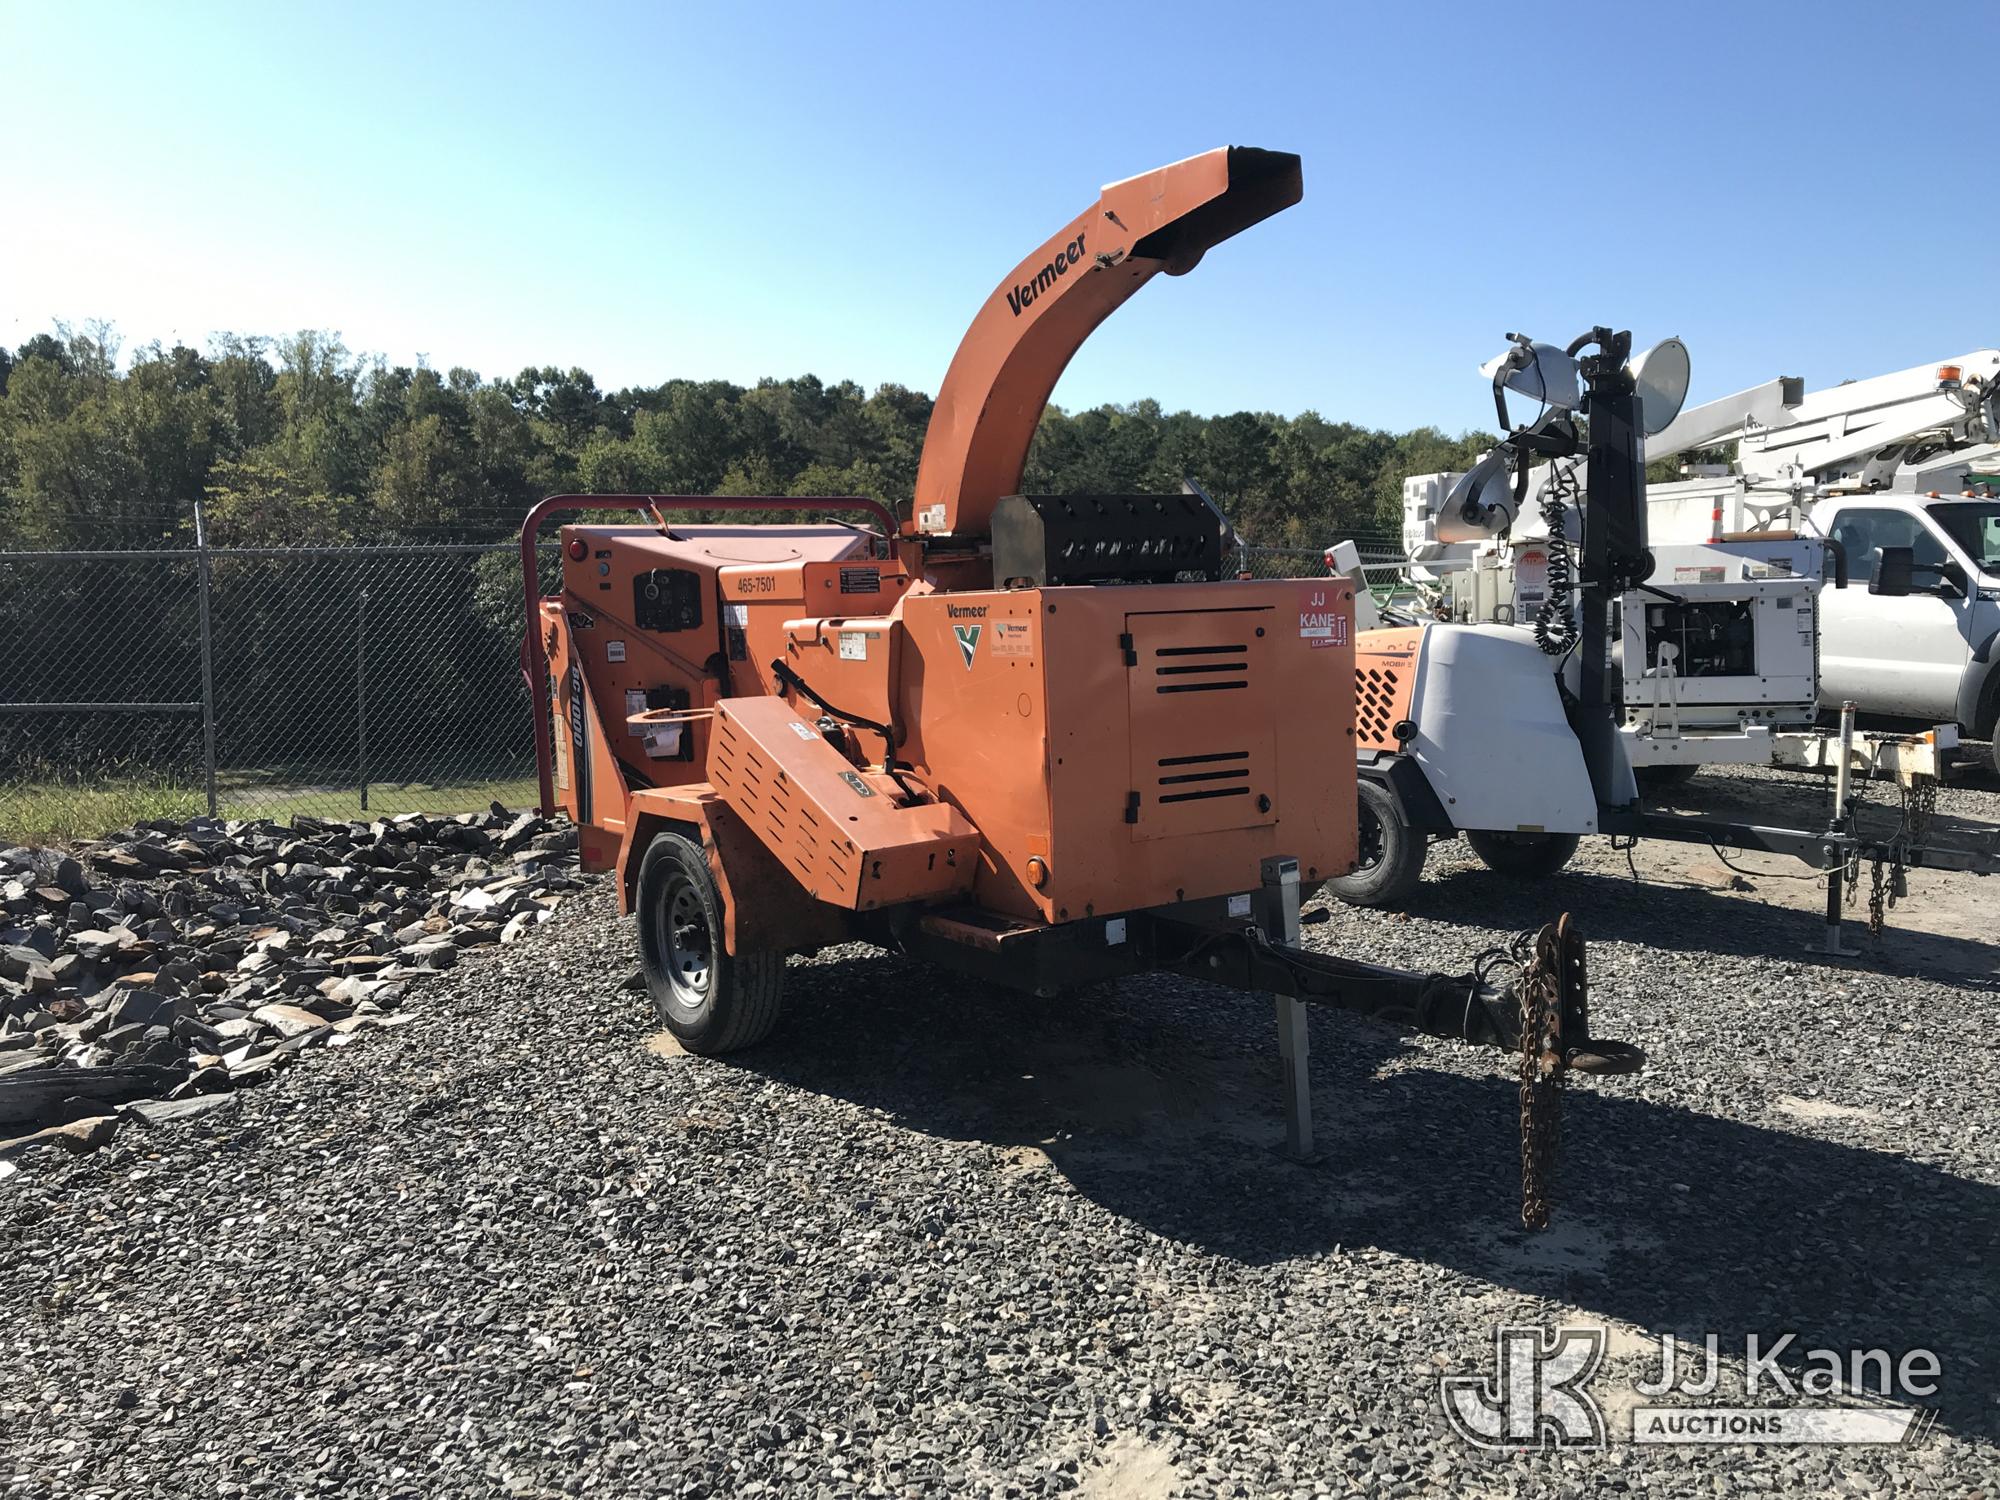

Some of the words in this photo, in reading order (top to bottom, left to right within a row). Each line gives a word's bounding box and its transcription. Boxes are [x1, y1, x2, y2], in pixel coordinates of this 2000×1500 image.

[1006, 232, 1086, 317] Vermeer
[738, 576, 776, 593] 465-7501
[1310, 592, 1325, 606] JJ
[947, 604, 988, 619] Vermeer
[1300, 613, 1336, 627] KANE
